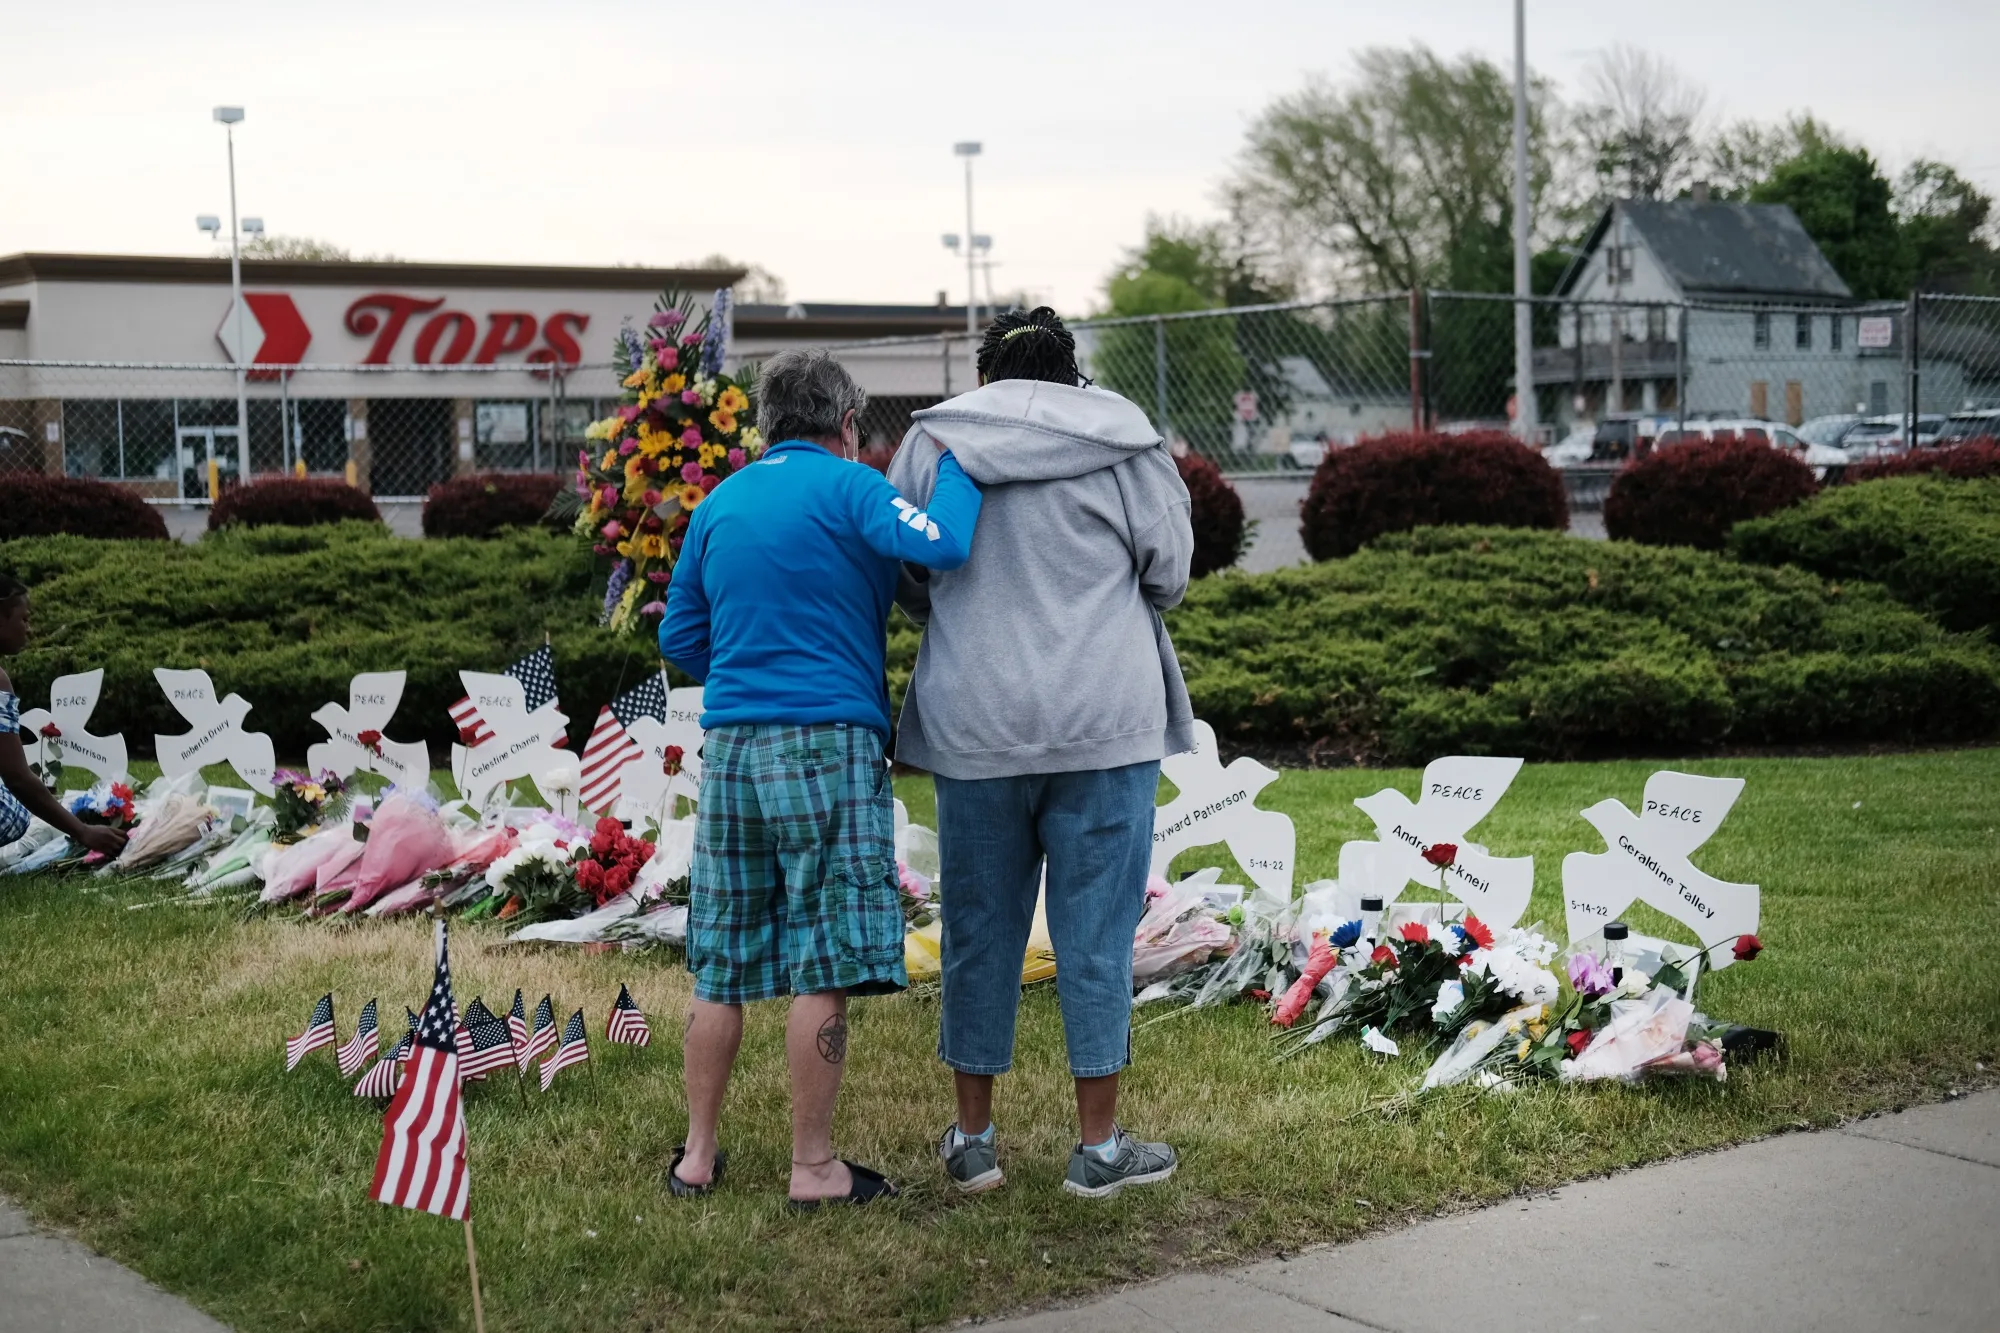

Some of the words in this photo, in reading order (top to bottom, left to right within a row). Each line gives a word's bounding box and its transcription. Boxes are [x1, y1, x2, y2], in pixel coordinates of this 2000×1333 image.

[344, 293, 590, 379] TOPS
[56, 696, 87, 707] PEACE
[174, 689, 204, 699] PEACE
[354, 694, 385, 705] PEACE
[479, 695, 513, 707] PEACE
[671, 710, 701, 722] PEAC
[181, 736, 209, 760] Roberta
[207, 719, 229, 739] Drury
[336, 727, 376, 756] Kathee
[70, 741, 107, 764] Morrison
[471, 751, 509, 778] Celestine
[510, 733, 540, 755] Chaney
[1432, 783, 1484, 801] PEACE
[1153, 813, 1192, 843] eyward
[1193, 790, 1247, 821] Patterson
[1647, 800, 1703, 823] PEACE
[1392, 824, 1429, 852] Andre
[1249, 858, 1284, 871] 5-14-22
[1618, 835, 1674, 886] Geraldine
[1678, 882, 1715, 919] Talley
[1571, 899, 1608, 917] 5-14-22
